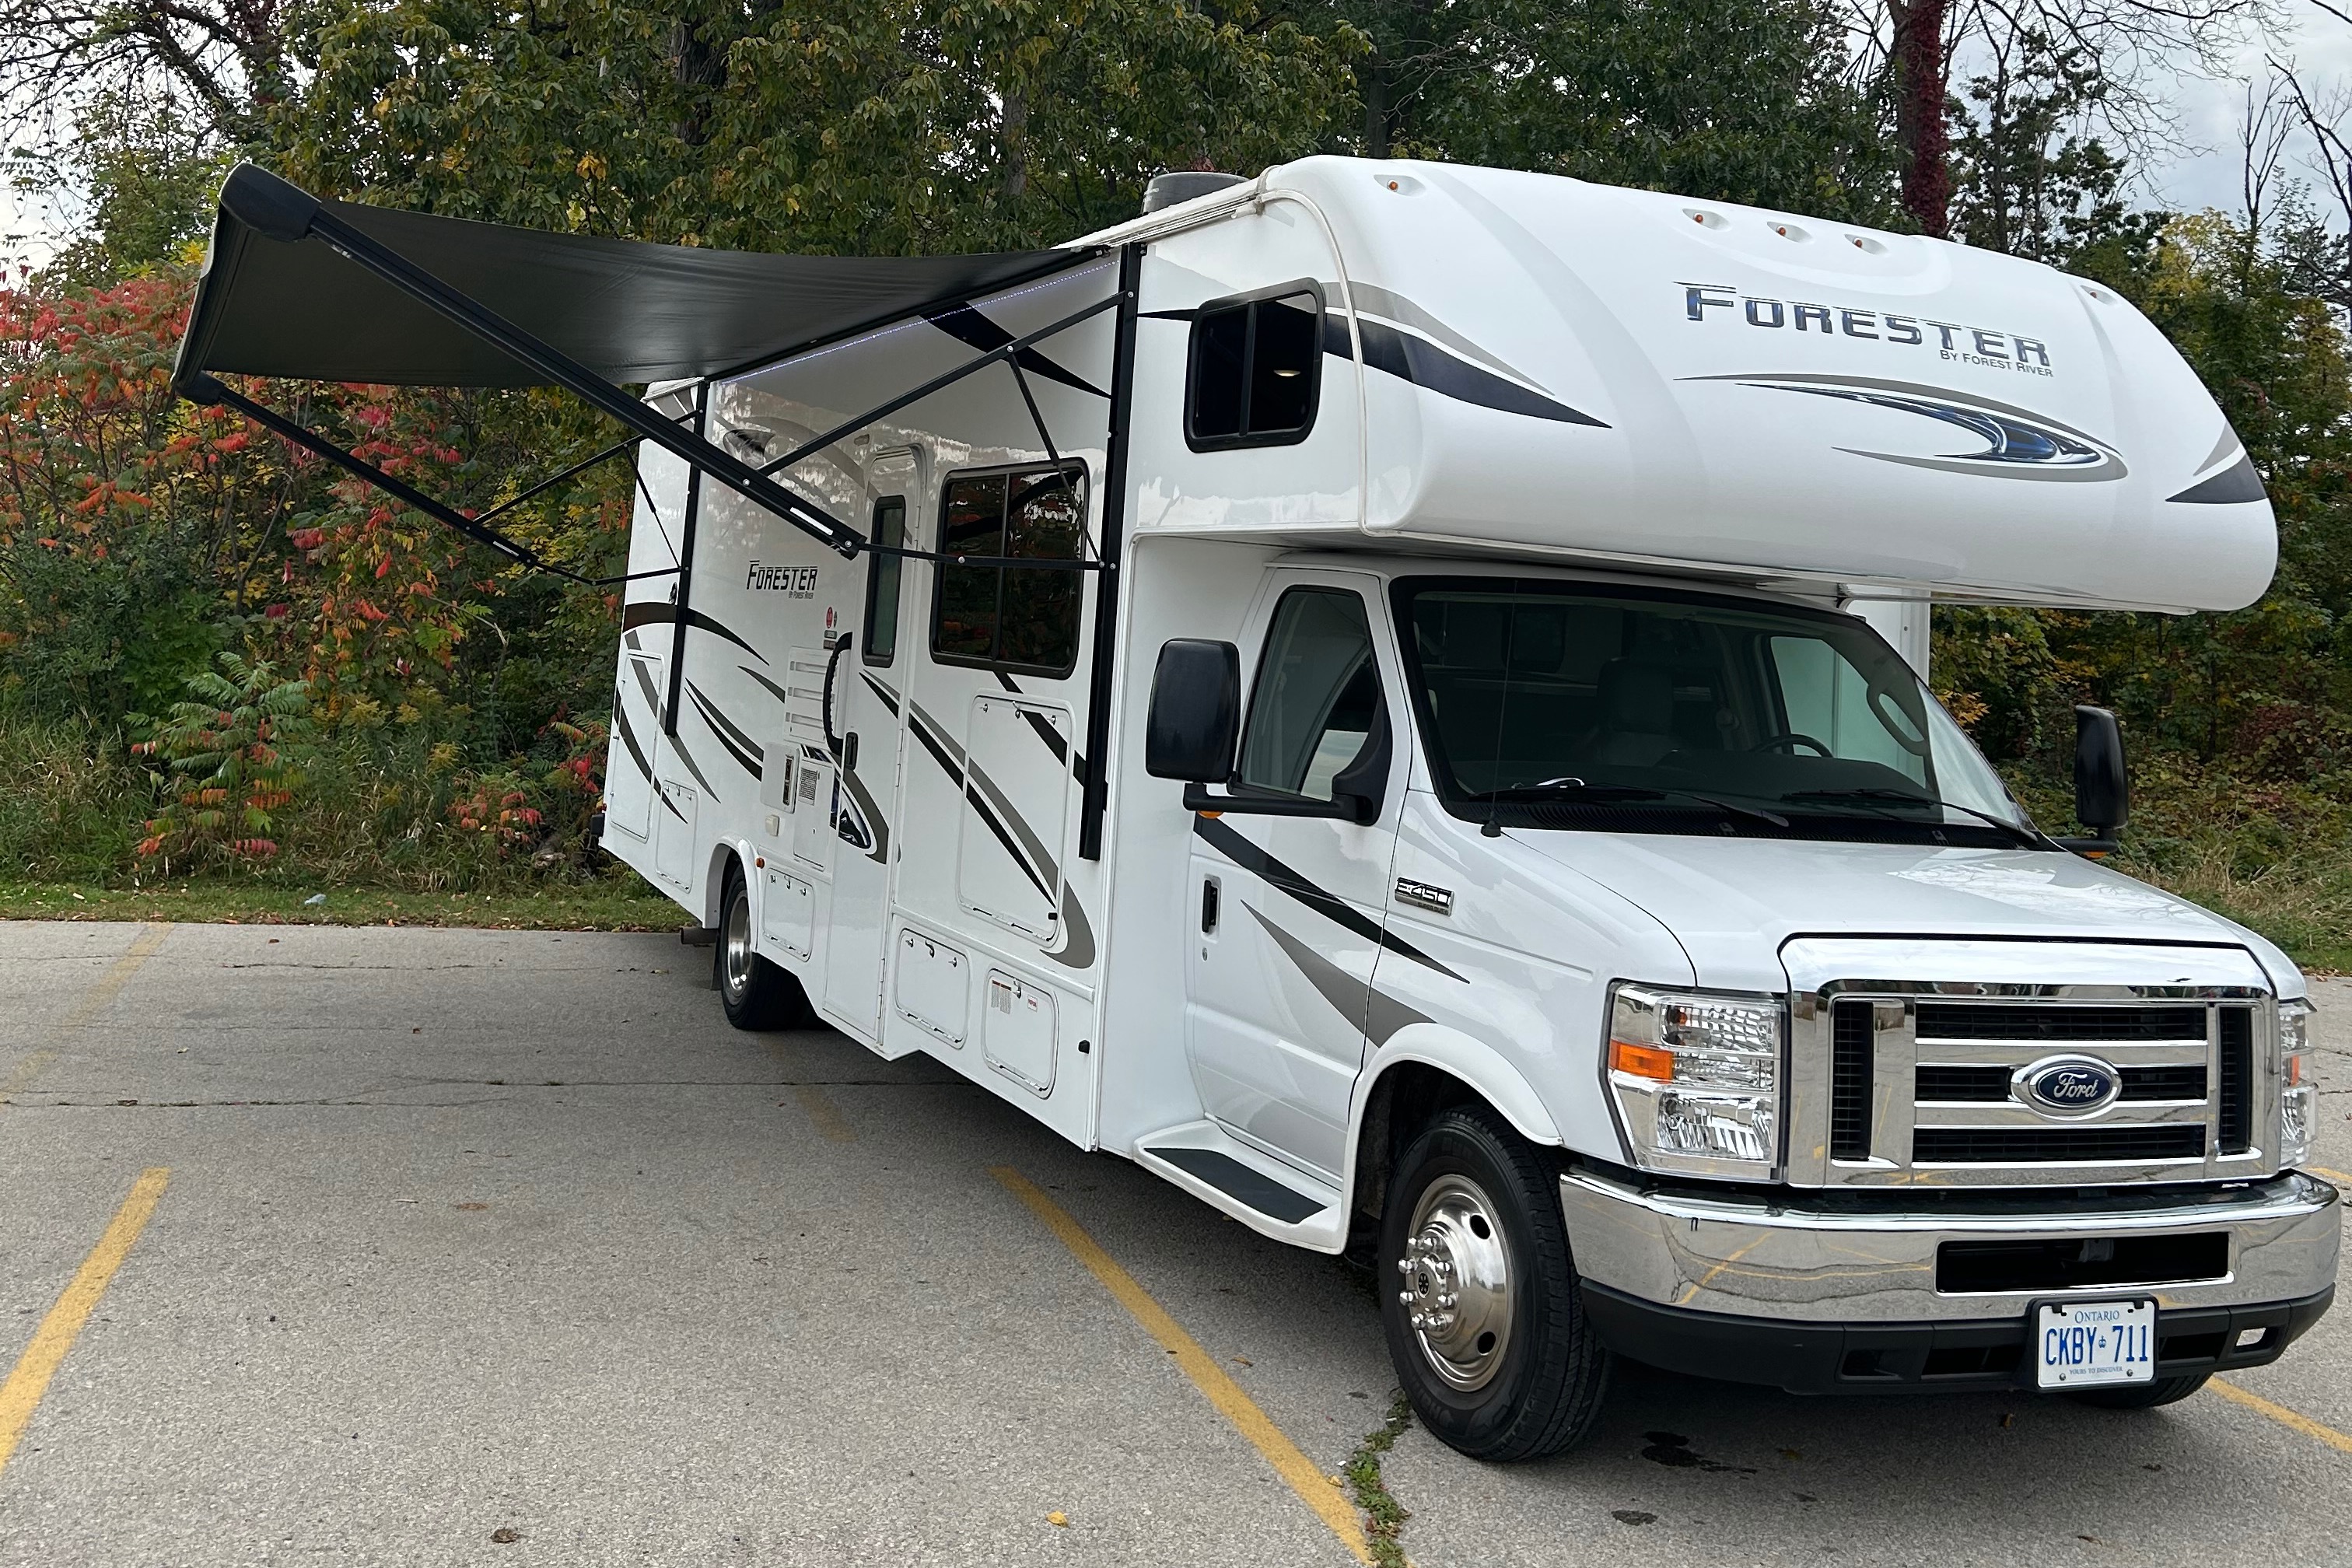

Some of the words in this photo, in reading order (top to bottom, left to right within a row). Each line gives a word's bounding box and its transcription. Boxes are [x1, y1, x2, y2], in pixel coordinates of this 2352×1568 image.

[1672, 282, 2051, 366] FORESTER
[1962, 352, 2012, 370] FOREST
[2016, 362, 2054, 378] RIVER
[746, 560, 818, 591] FORESTER
[2053, 1072, 2099, 1098] Ford
[2074, 1310, 2120, 1324] ONTARIO
[2046, 1325, 2098, 1366] CKBY
[2112, 1324, 2148, 1363] 711
